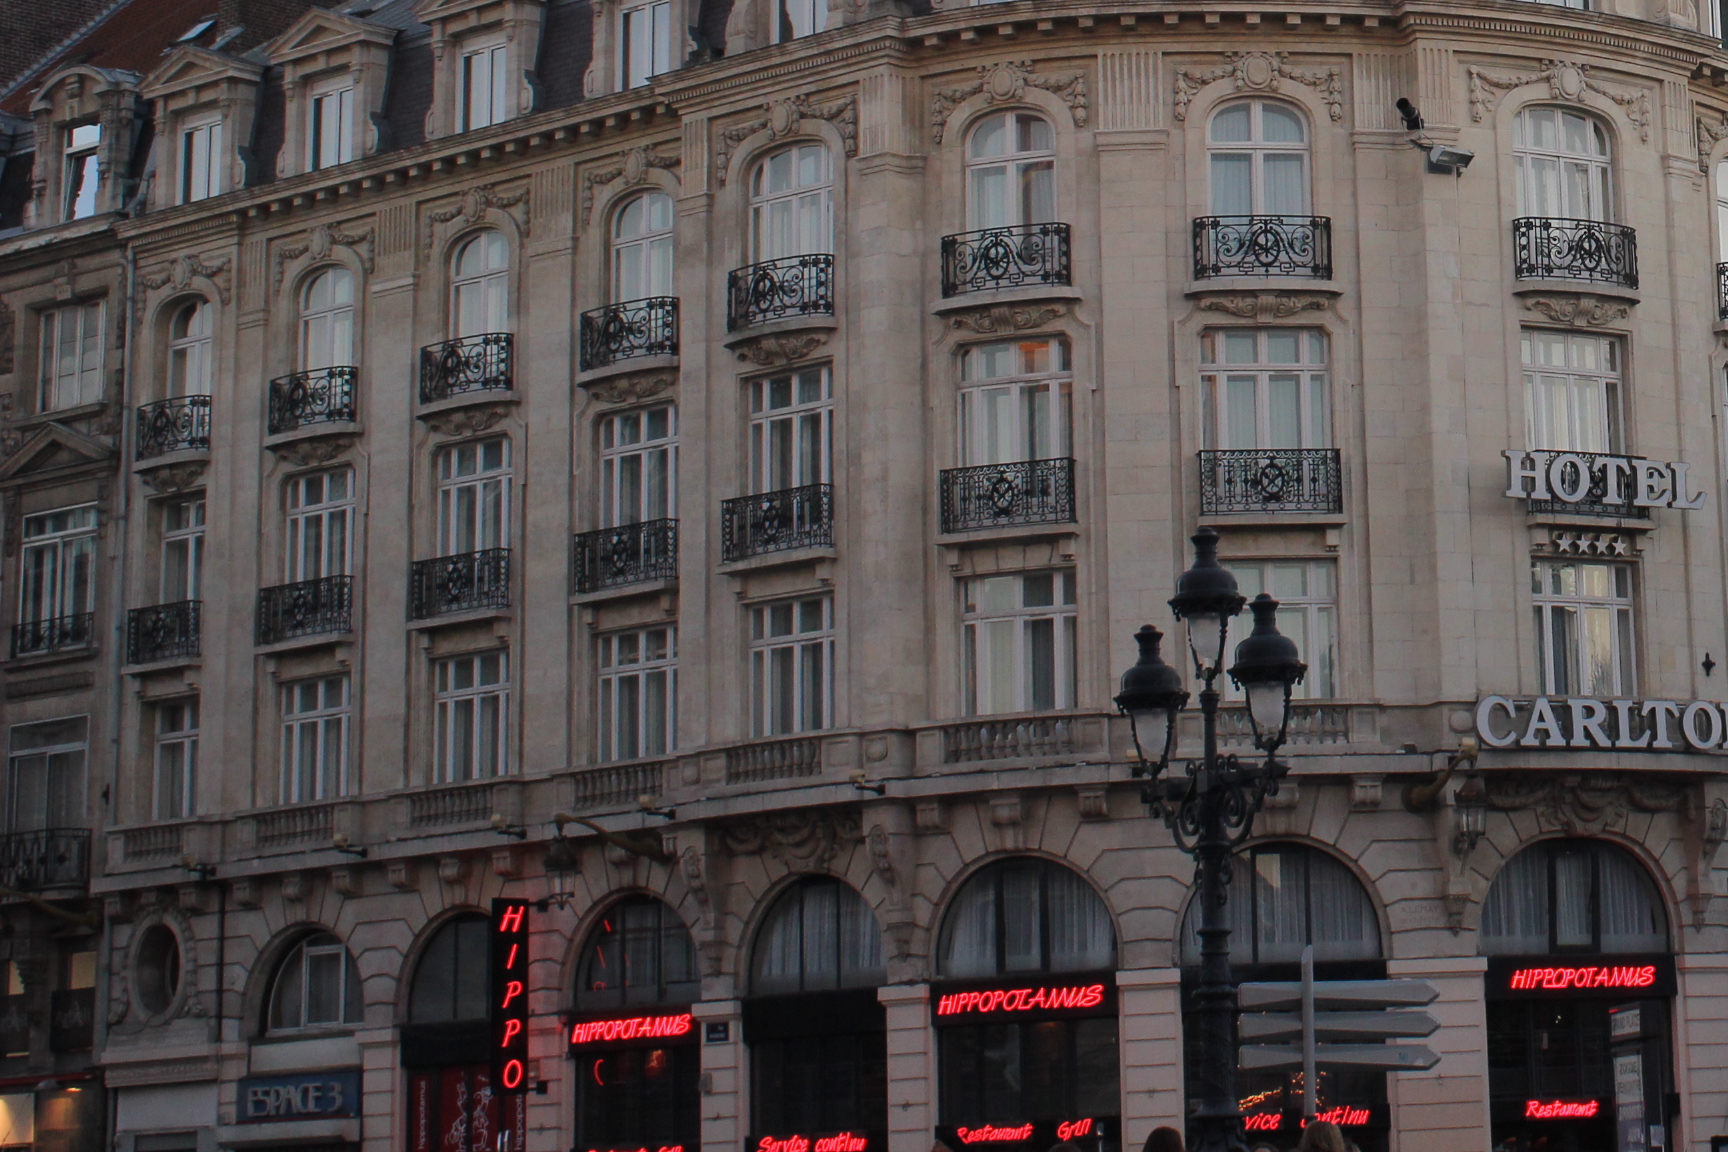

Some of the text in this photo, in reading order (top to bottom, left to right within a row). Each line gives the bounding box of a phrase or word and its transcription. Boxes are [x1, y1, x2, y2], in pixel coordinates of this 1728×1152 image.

[1501, 450, 1707, 510] HOTEL
[1510, 965, 1657, 989] HIPPOPOTAMUS
[499, 905, 526, 1089] HIPPO
[937, 984, 1105, 1015] HIPPOPOTAMUS
[571, 1013, 692, 1044] HIPPOPOTAMUS
[247, 1081, 344, 1118] ESPACE 3
[1525, 1099, 1599, 1118] Restaurant
[956, 1121, 1035, 1144] Restaurant
